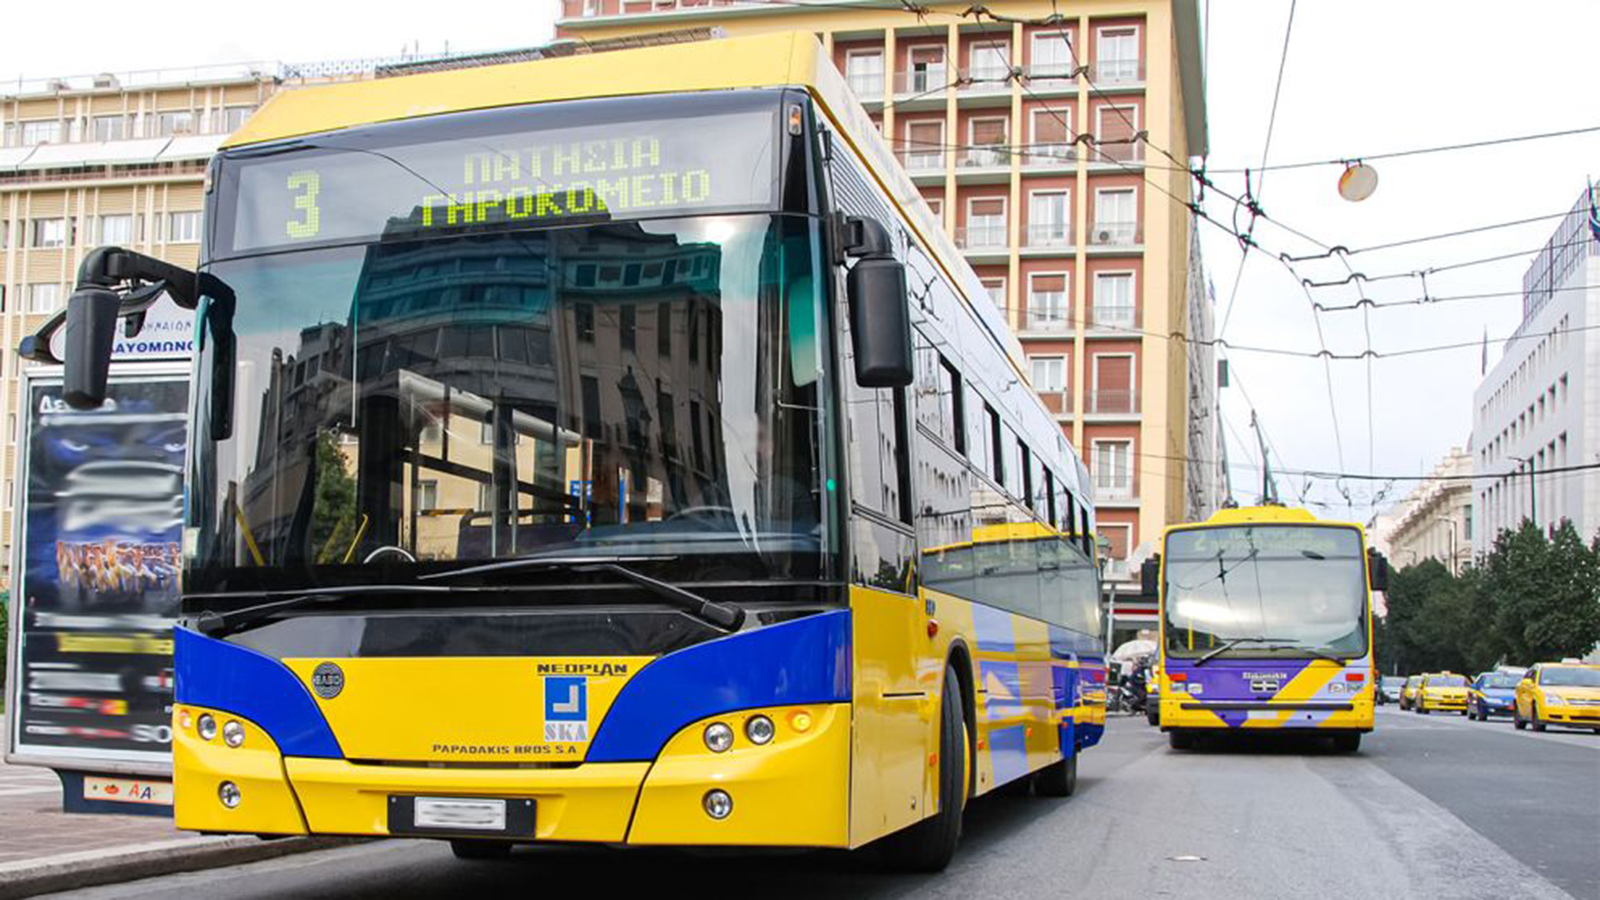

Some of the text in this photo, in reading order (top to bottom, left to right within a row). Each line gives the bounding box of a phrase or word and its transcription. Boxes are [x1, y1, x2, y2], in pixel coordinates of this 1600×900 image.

[286, 170, 321, 238] 3
[537, 663, 627, 676] NEOPLAN
[545, 723, 587, 741] SKA
[433, 744, 510, 754] PAPADAKIS
[514, 745, 551, 754] BROS
